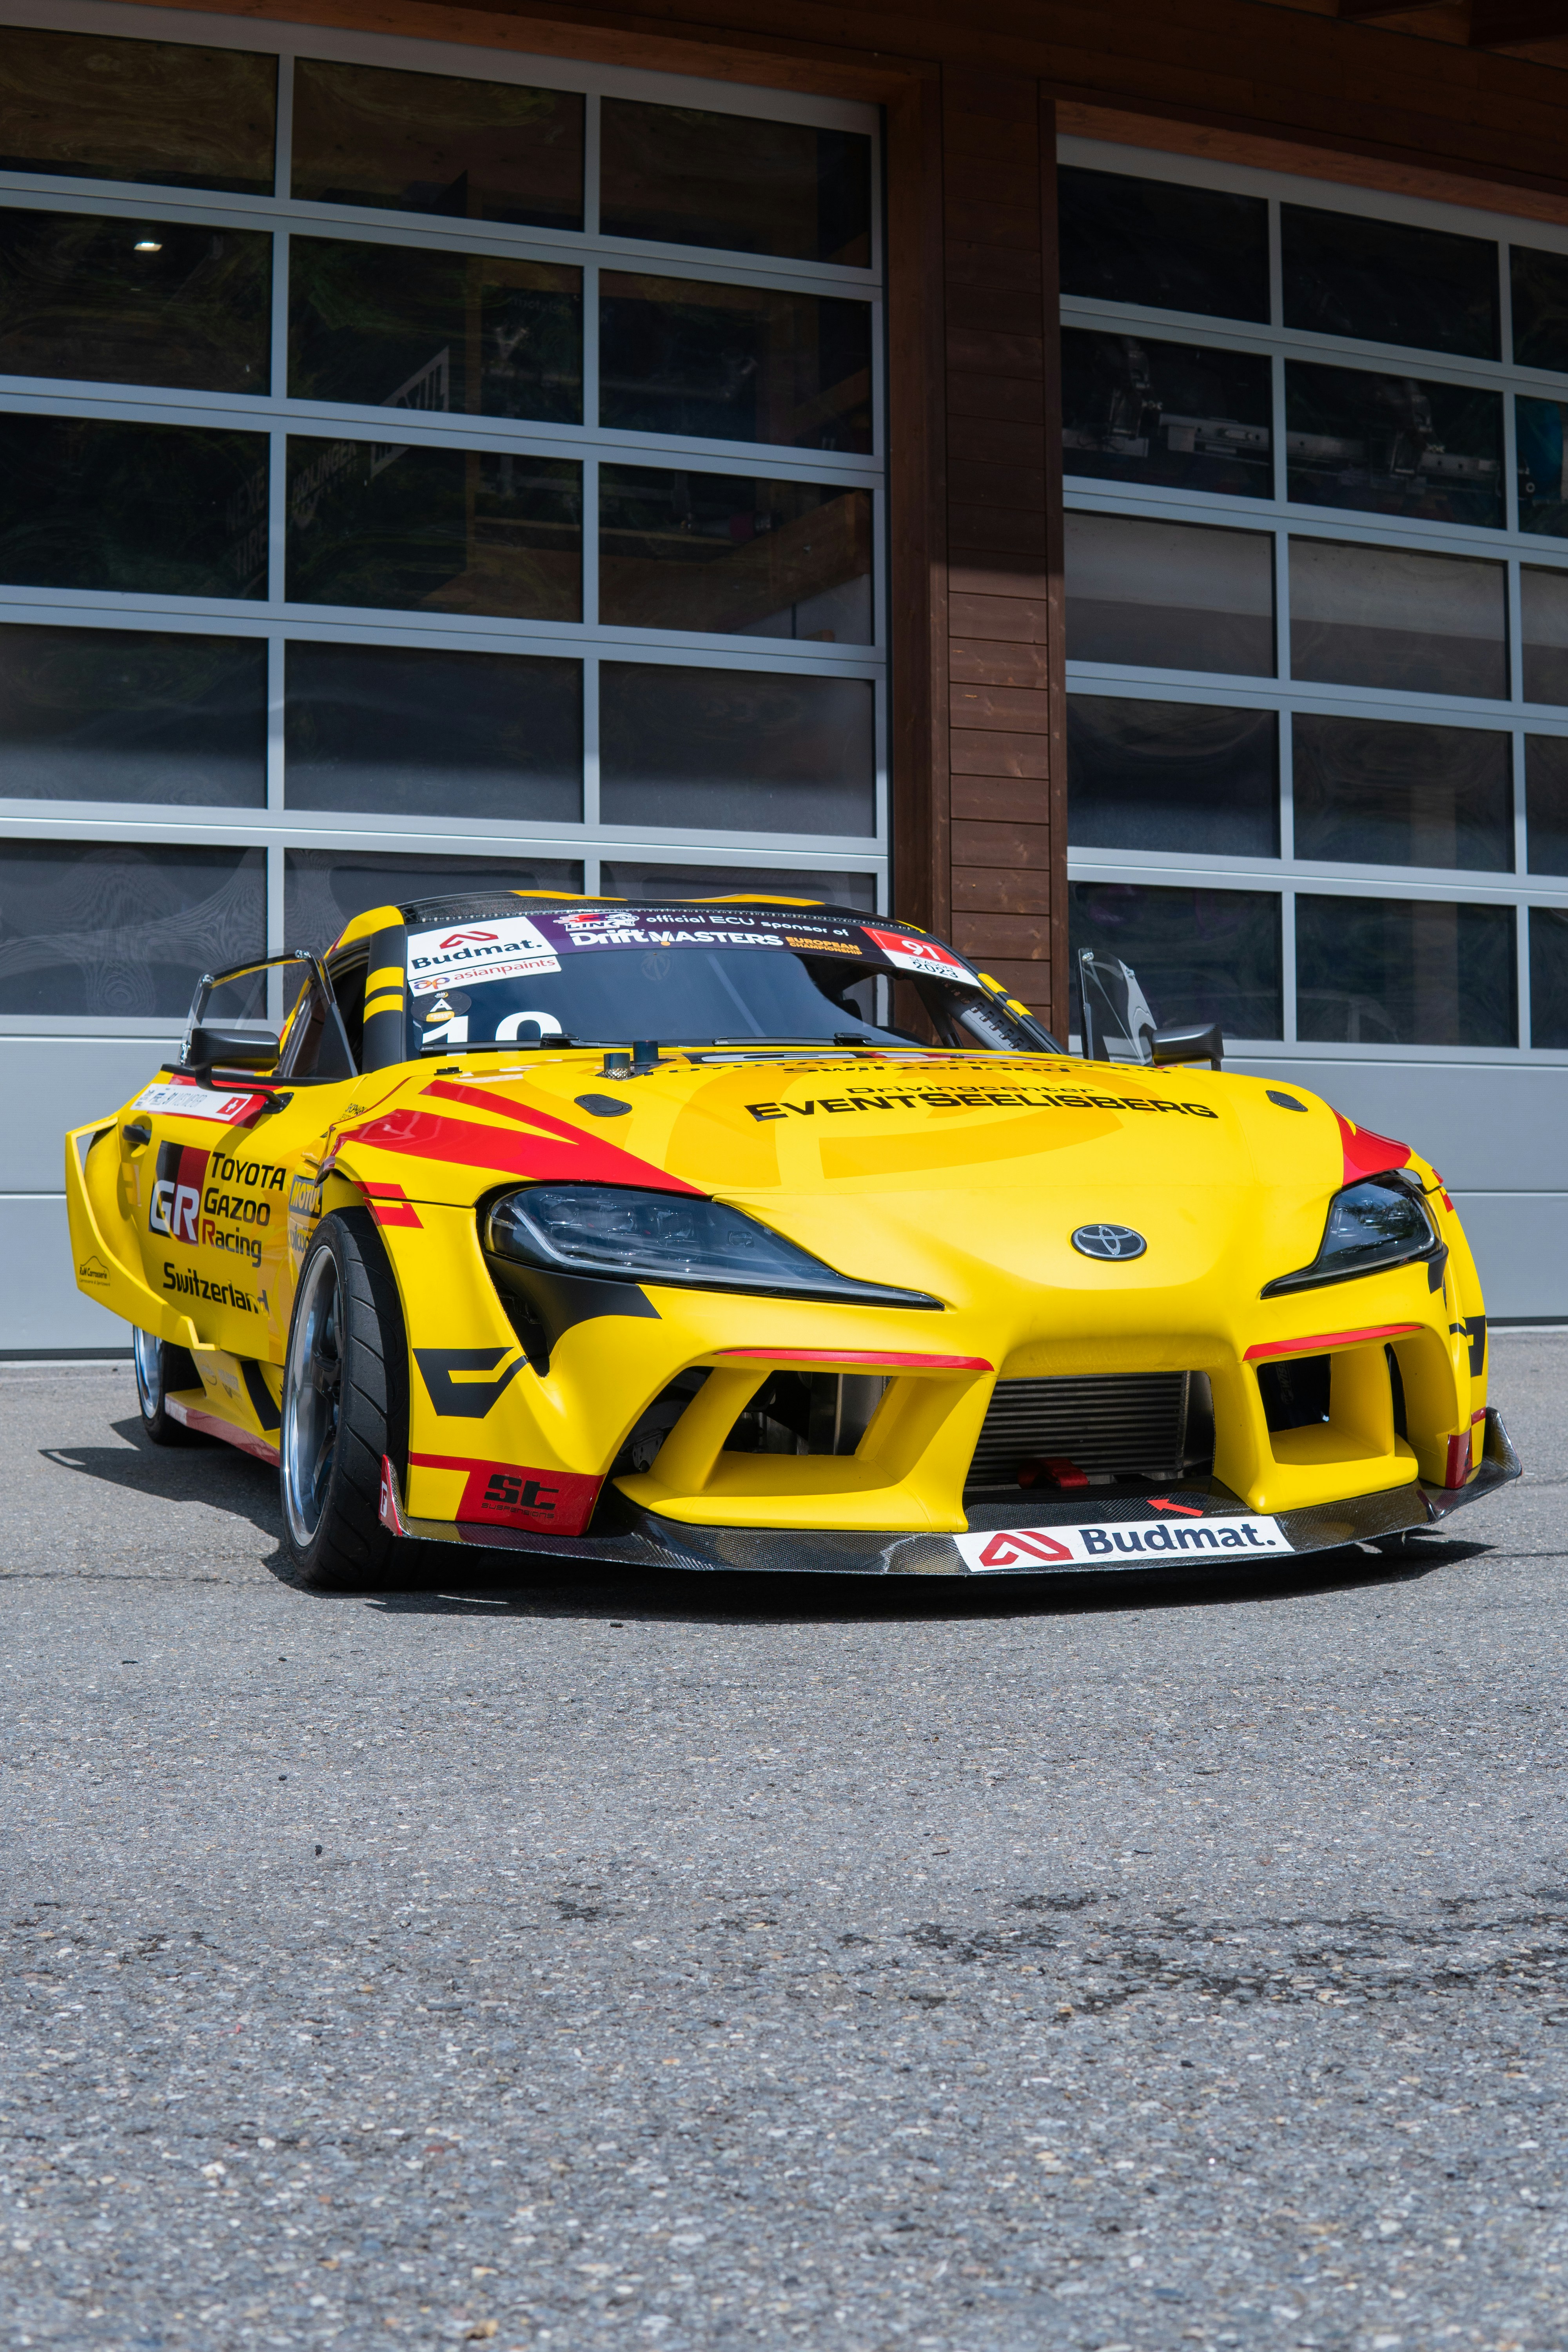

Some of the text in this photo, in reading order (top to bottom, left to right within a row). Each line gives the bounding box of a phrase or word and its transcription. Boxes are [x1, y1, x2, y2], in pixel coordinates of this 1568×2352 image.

[567, 920, 619, 929] LINK
[646, 915, 706, 924] official
[709, 916, 755, 926] ECU
[760, 921, 827, 934] sponsor
[569, 929, 784, 946] Drift MASTERS
[785, 936, 860, 951] EUROPEAN
[411, 939, 543, 969] Budmat.
[789, 942, 862, 955] CHAMPIONSHIP
[901, 940, 941, 961] 91
[454, 959, 555, 980] asianpaints
[909, 956, 953, 971] SEASON
[913, 961, 958, 978] 2023
[430, 998, 452, 1012] A
[845, 1085, 1095, 1094] Drivingcenter
[744, 1093, 1219, 1122] EVENTSEELISBERG
[211, 1151, 287, 1191] TOYOTA
[204, 1187, 270, 1226] GAZOO
[290, 1181, 321, 1213] MOTUL
[151, 1180, 200, 1241] GR
[202, 1218, 262, 1268] Racing
[163, 1261, 270, 1316] Switzerland
[481, 1503, 555, 1519] SUSPENSIONS
[1078, 1523, 1276, 1555] Budmat.
